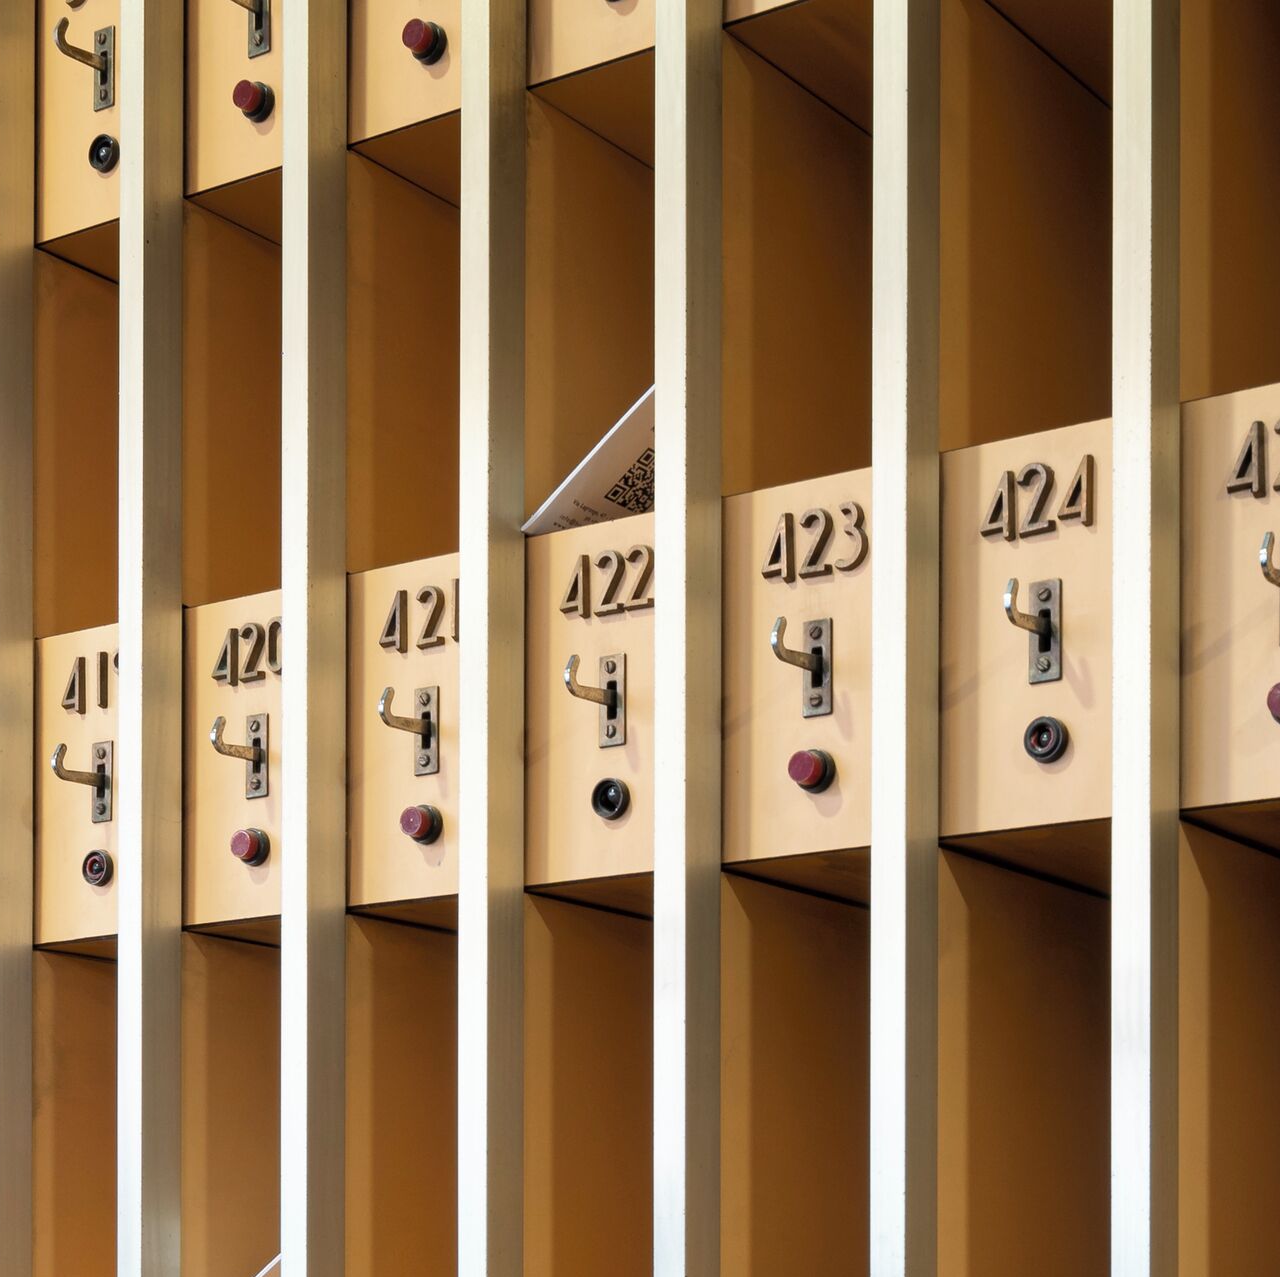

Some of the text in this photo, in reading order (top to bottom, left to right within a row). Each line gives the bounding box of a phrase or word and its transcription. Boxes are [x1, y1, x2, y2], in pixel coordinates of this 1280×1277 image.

[980, 454, 1095, 542] 424
[559, 544, 655, 619] 422
[761, 501, 869, 583] 423
